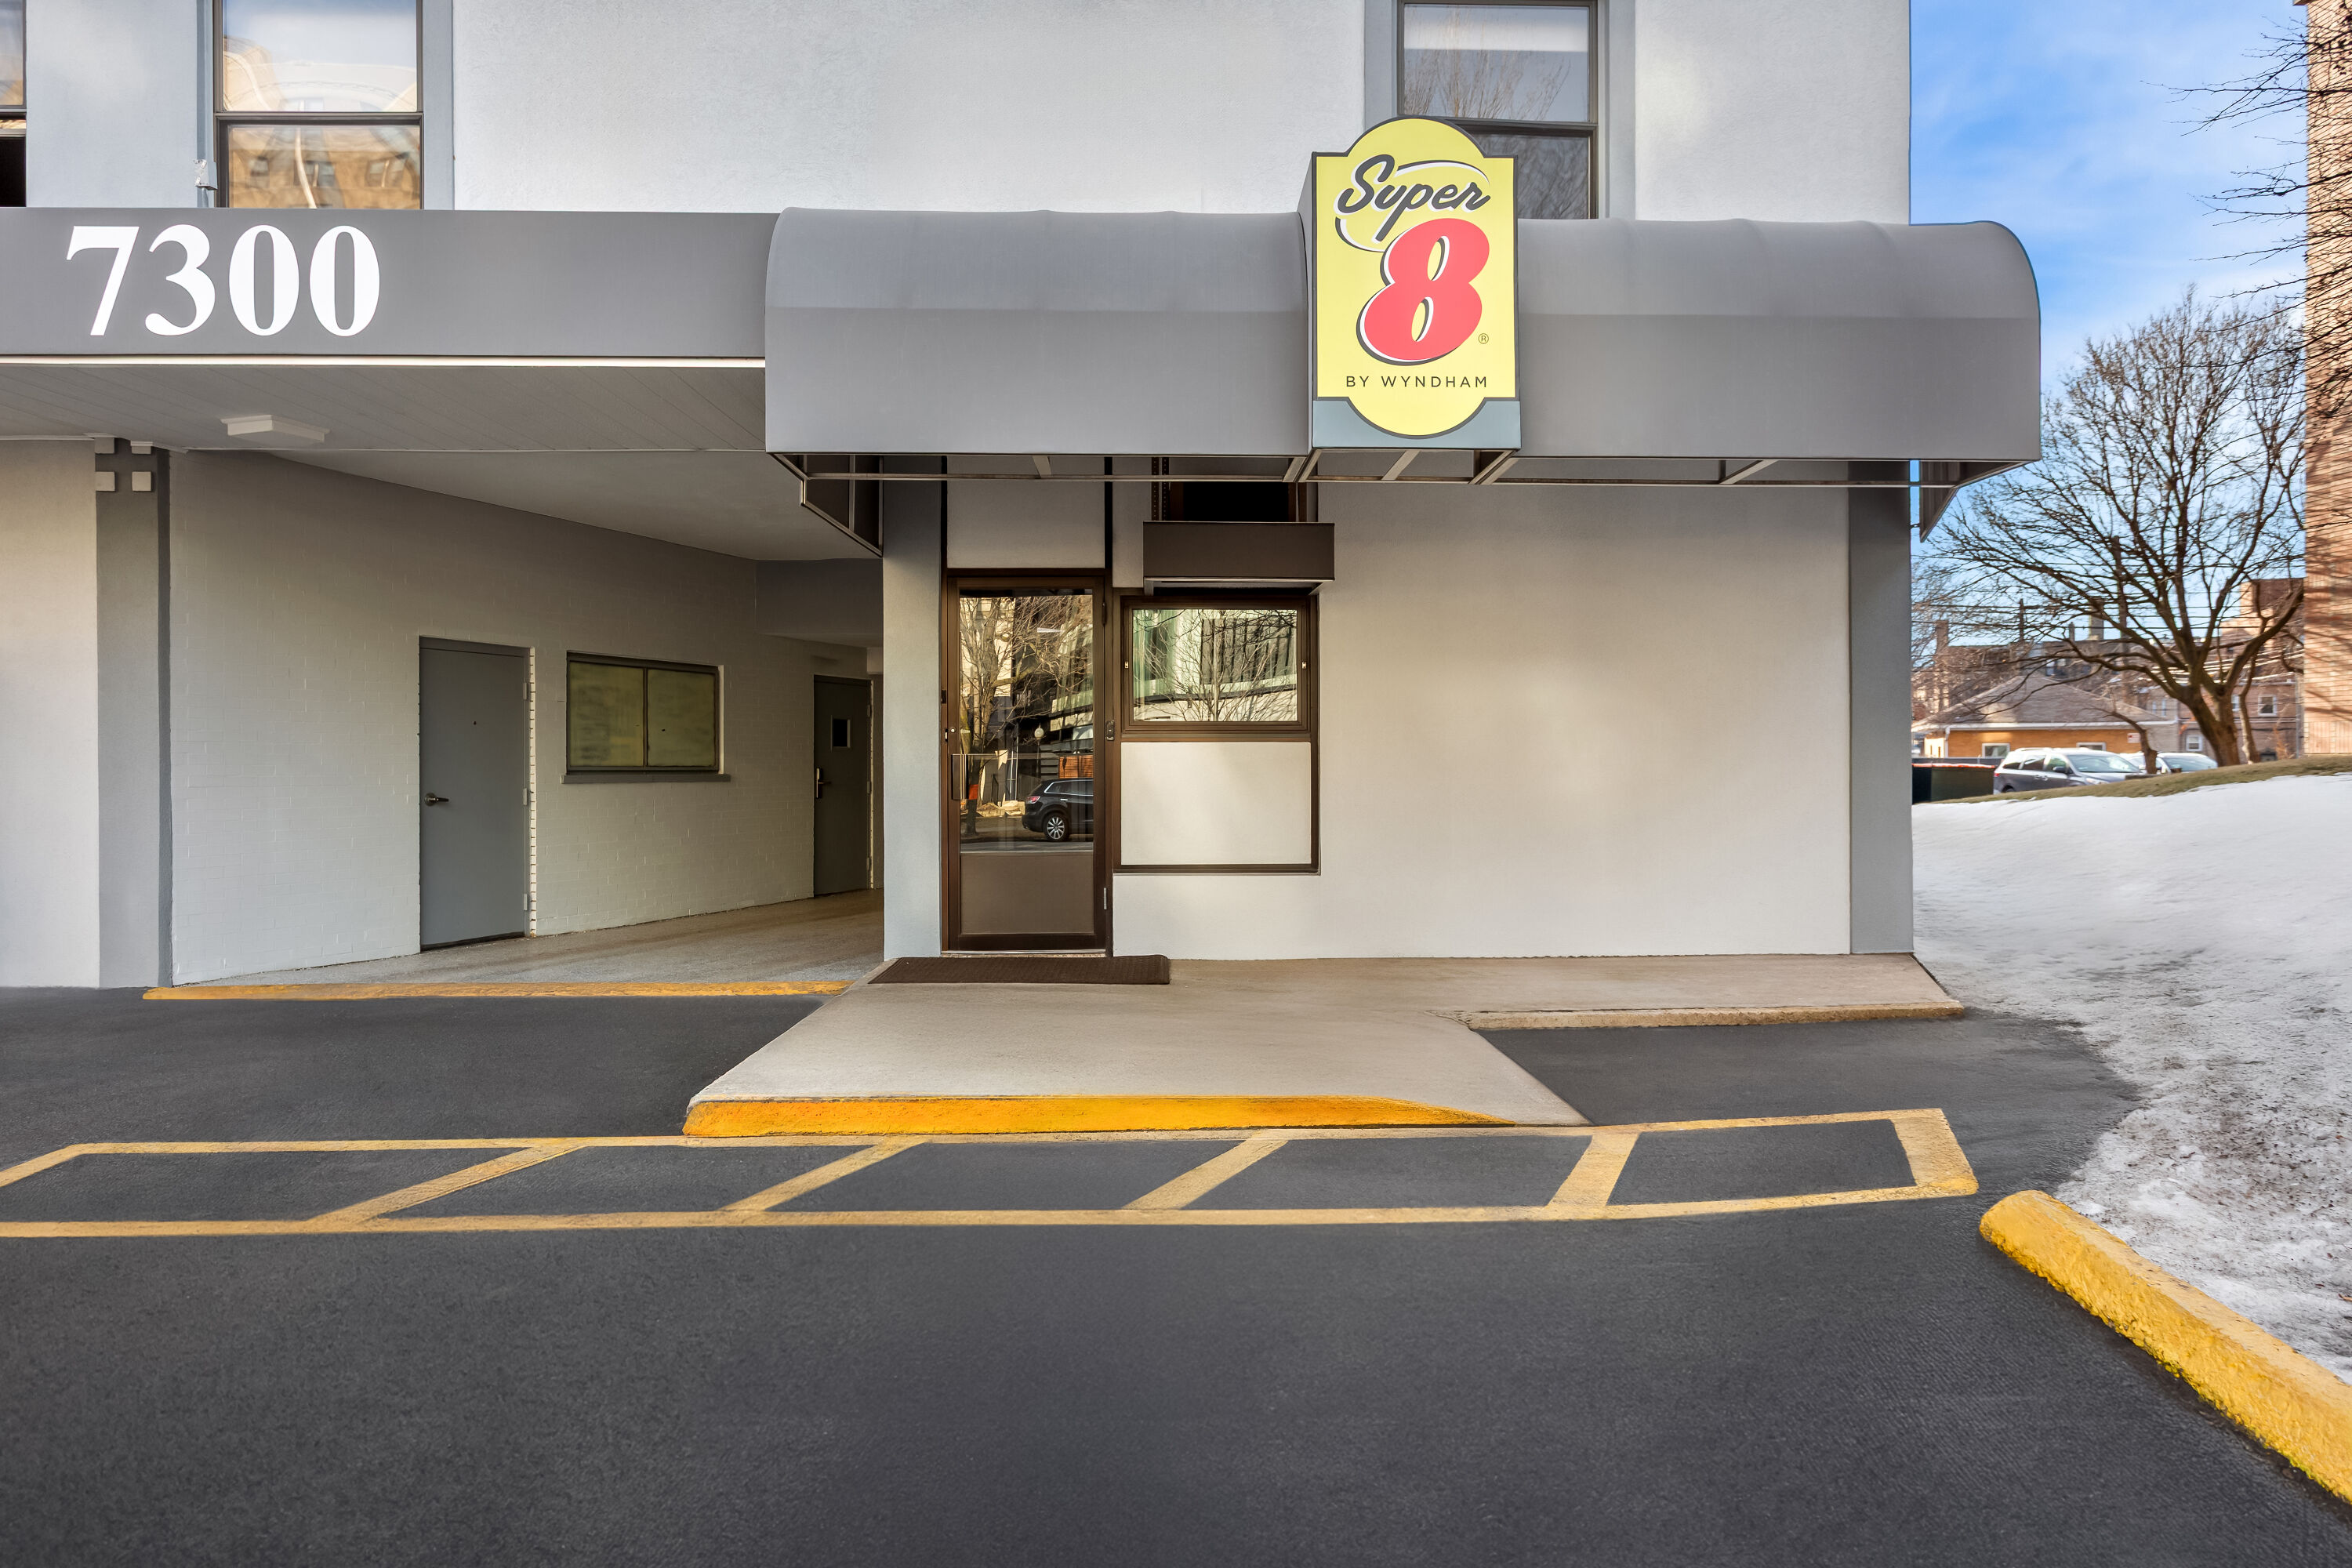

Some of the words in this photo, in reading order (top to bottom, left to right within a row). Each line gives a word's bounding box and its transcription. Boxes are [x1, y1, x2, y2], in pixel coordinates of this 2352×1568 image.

[1335, 154, 1491, 244] Super
[66, 224, 380, 337] 7300
[1356, 218, 1490, 367] 8
[1345, 376, 1370, 388] BY
[1381, 376, 1487, 389] WYNDHAM
